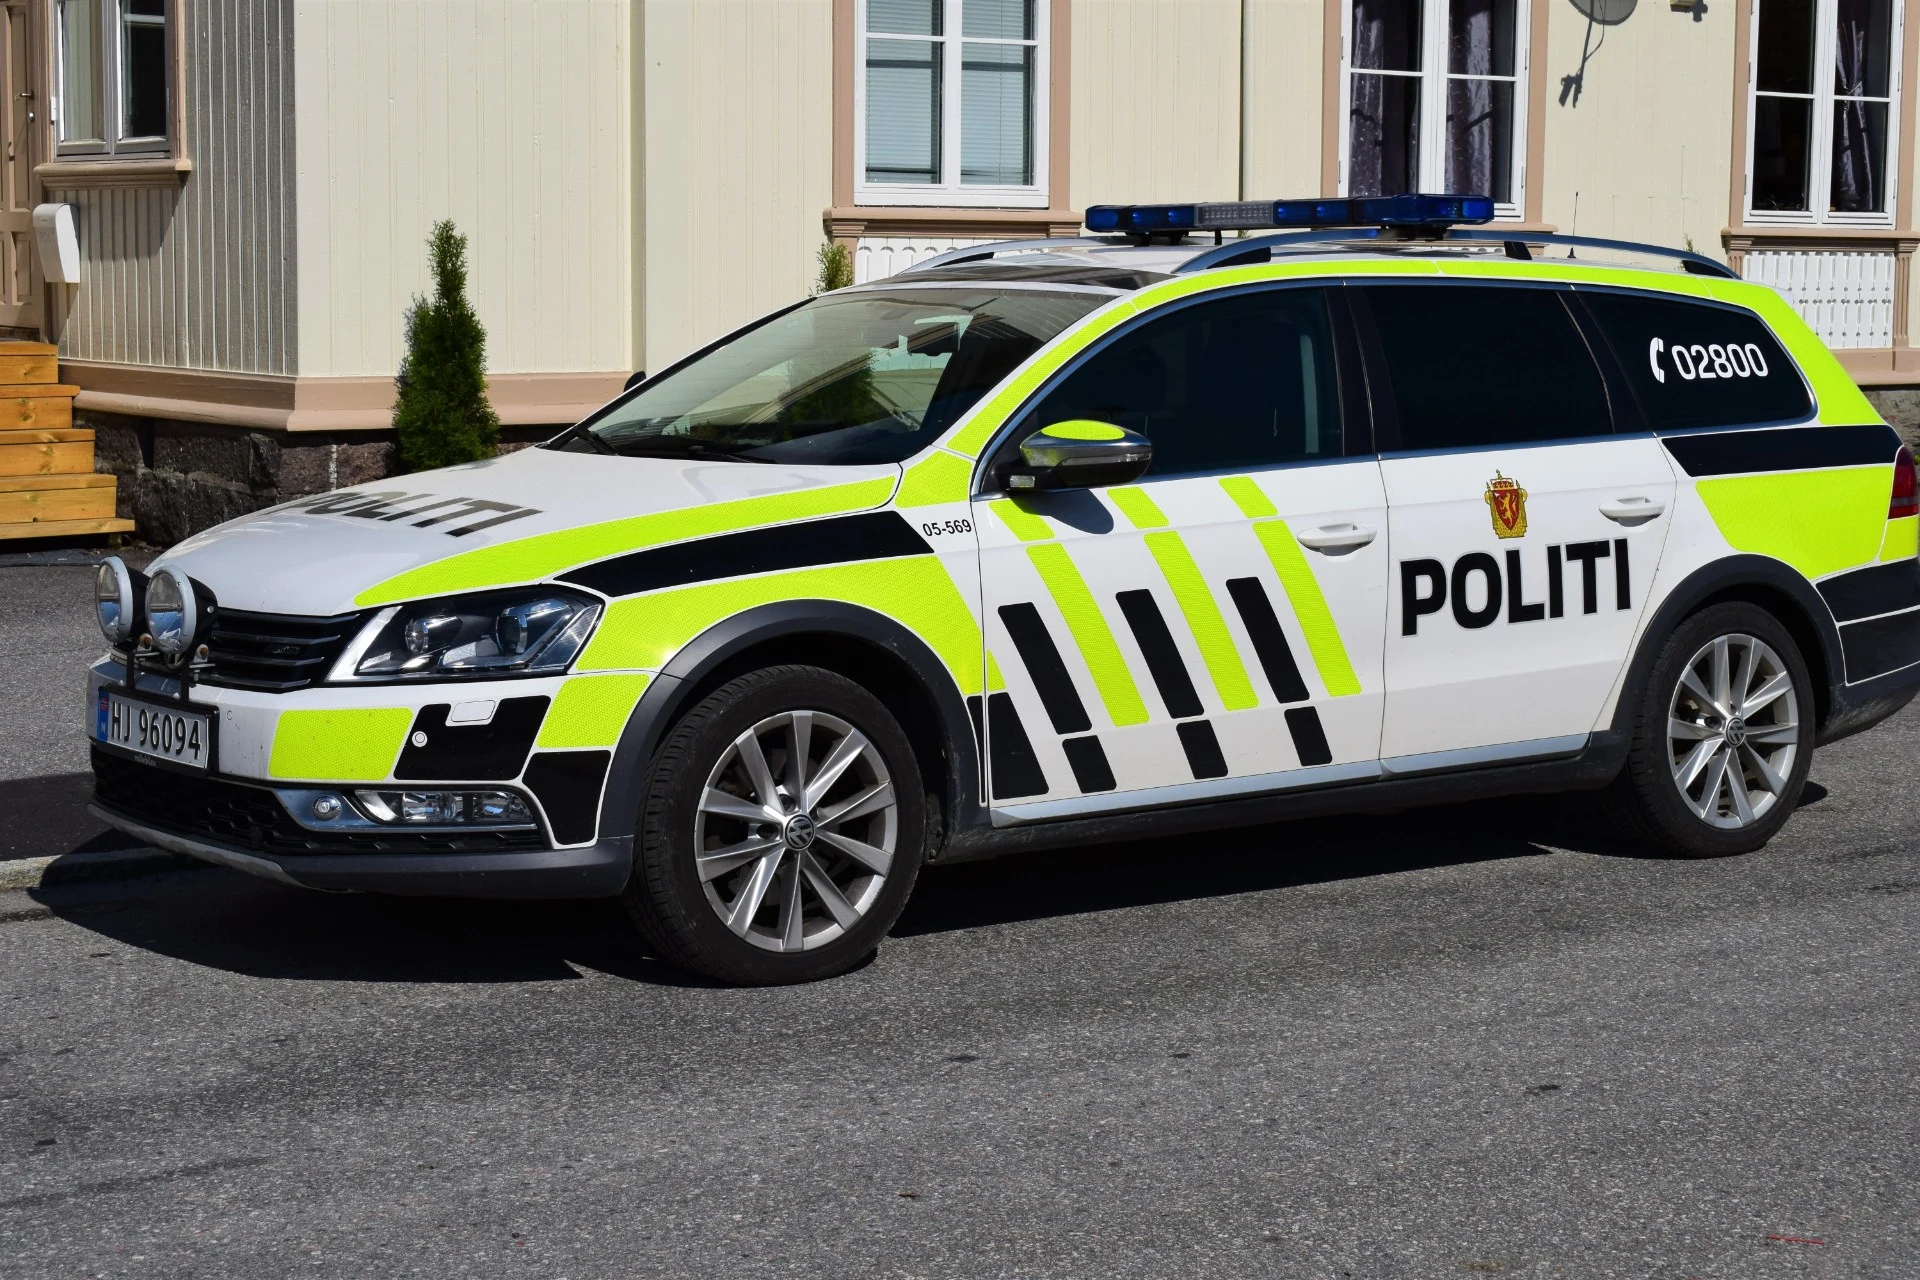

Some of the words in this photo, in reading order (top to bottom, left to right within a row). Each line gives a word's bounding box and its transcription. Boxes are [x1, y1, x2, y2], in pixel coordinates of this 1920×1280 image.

[1671, 343, 1769, 380] 02800
[922, 518, 972, 537] 05-569
[1401, 538, 1632, 637] POLITI
[111, 701, 132, 742] HJ
[139, 708, 202, 760] 96094
